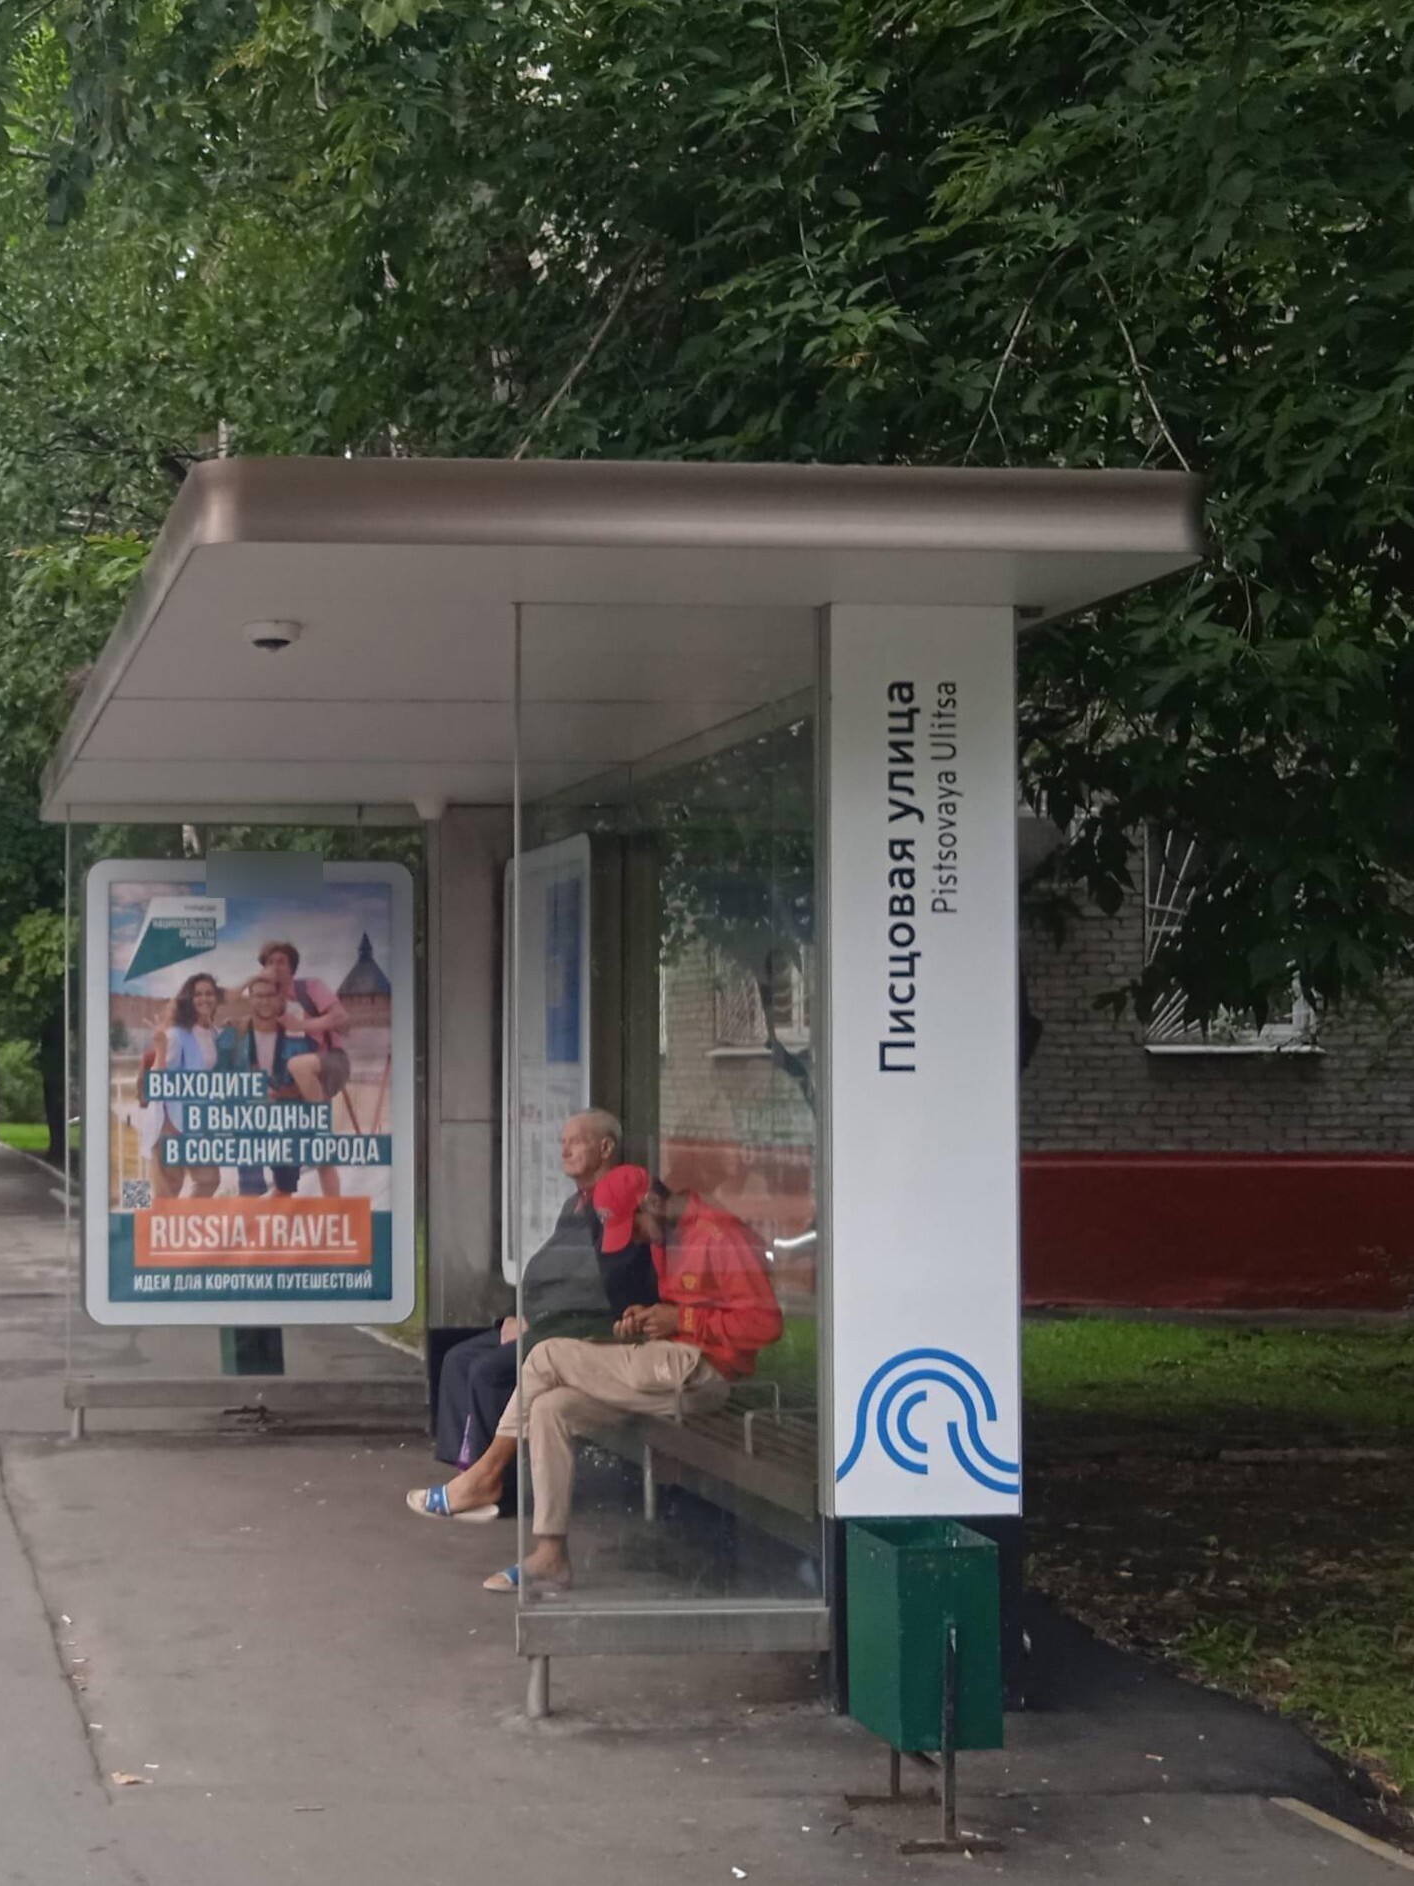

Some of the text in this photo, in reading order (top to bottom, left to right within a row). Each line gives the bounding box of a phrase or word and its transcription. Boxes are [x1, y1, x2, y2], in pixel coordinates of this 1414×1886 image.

[930, 681, 964, 914] Pistsovaya Ulitsa
[879, 680, 924, 1073] Писцовая улица
[148, 1072, 264, 1100] ВЫХОДИТЕ
[188, 1105, 329, 1133] В ВЫХОДНЫЕ
[166, 1137, 380, 1165] В СОСЕДНИЕ ГОРОДА
[150, 1213, 358, 1249] RUSSIA.TRAVEL
[133, 1270, 373, 1292] ИДЕИ ДЛЯ КОРОТКИХ ПУТЕШЕСТВИЙ
